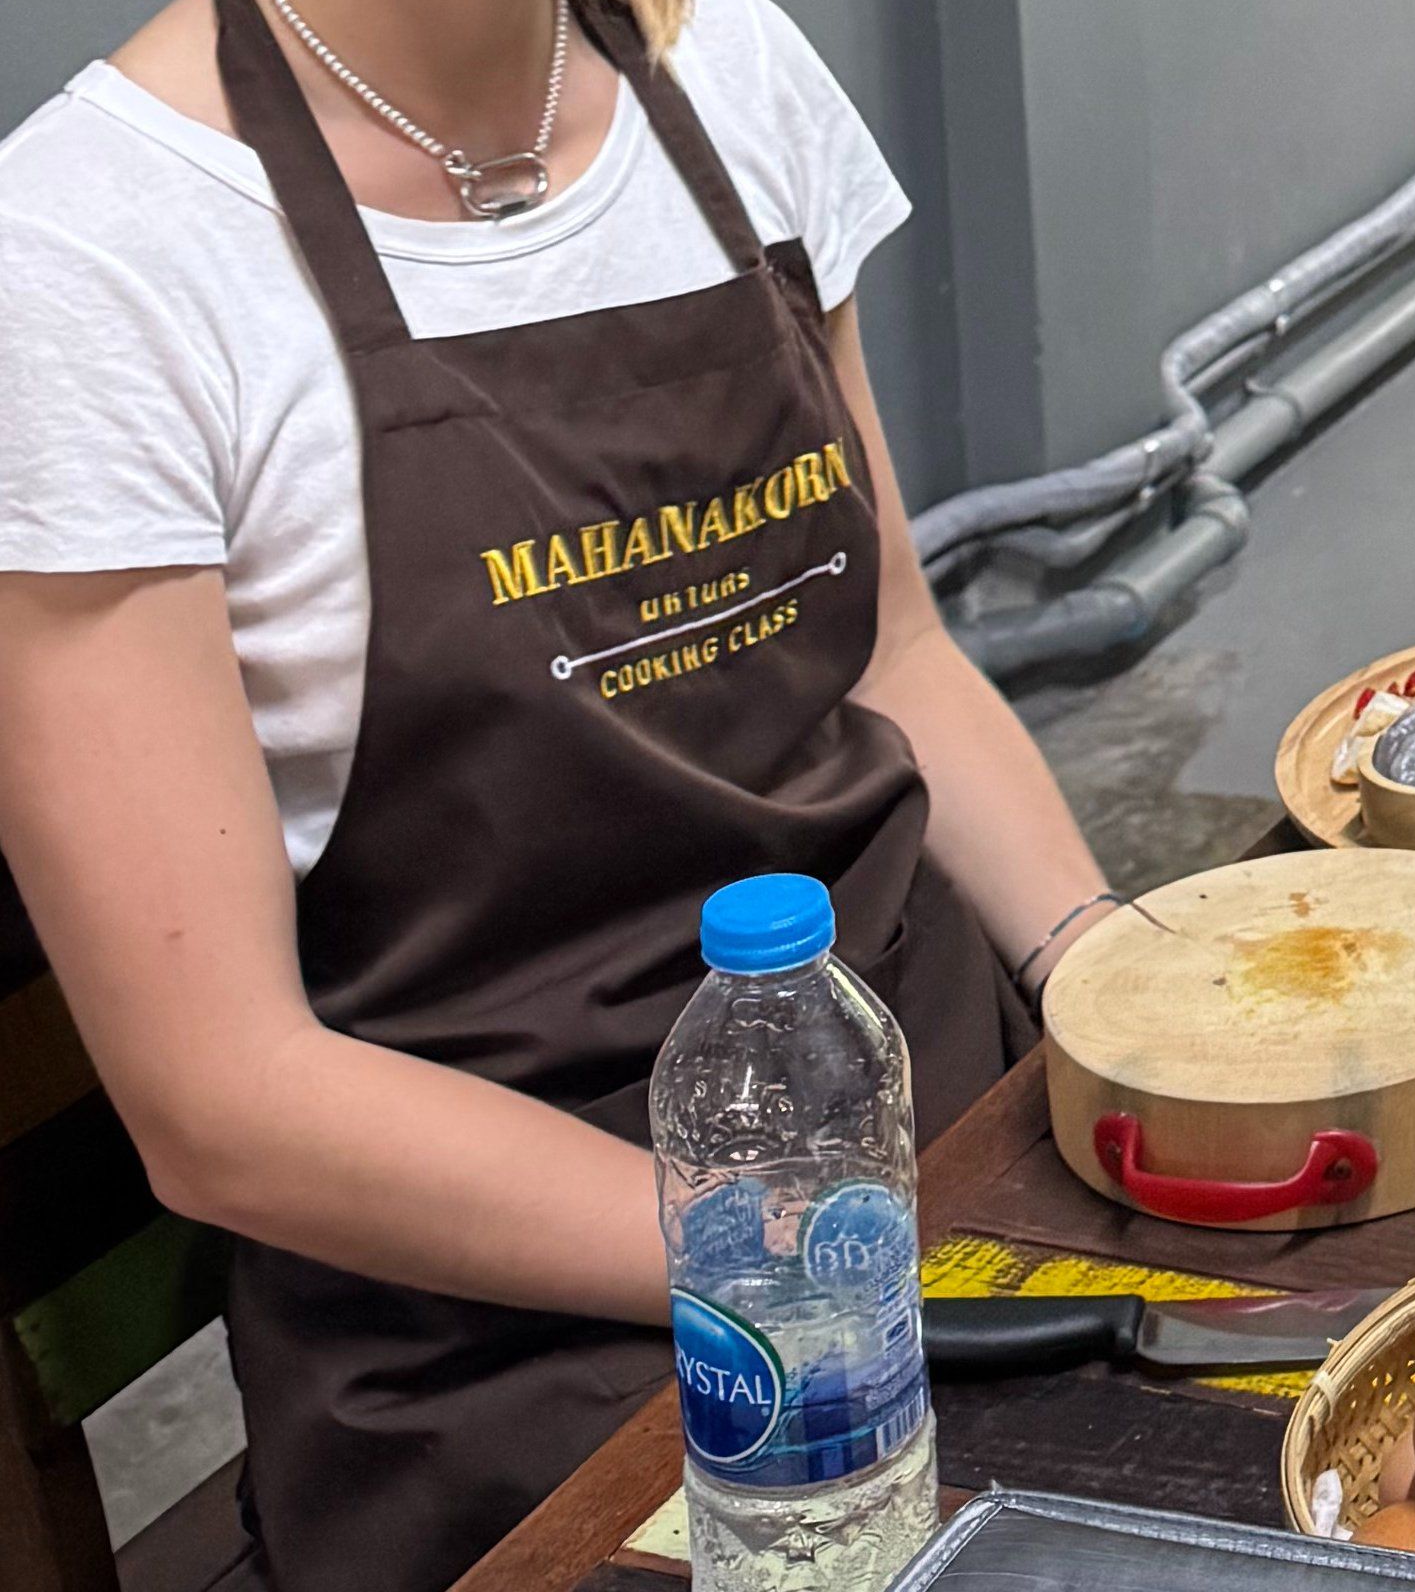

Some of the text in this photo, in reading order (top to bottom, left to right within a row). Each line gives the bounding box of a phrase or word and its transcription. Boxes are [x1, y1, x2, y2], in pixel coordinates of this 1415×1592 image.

[480, 438, 852, 607] MAHANAKORN
[600, 599, 799, 699] COOKING CLASS
